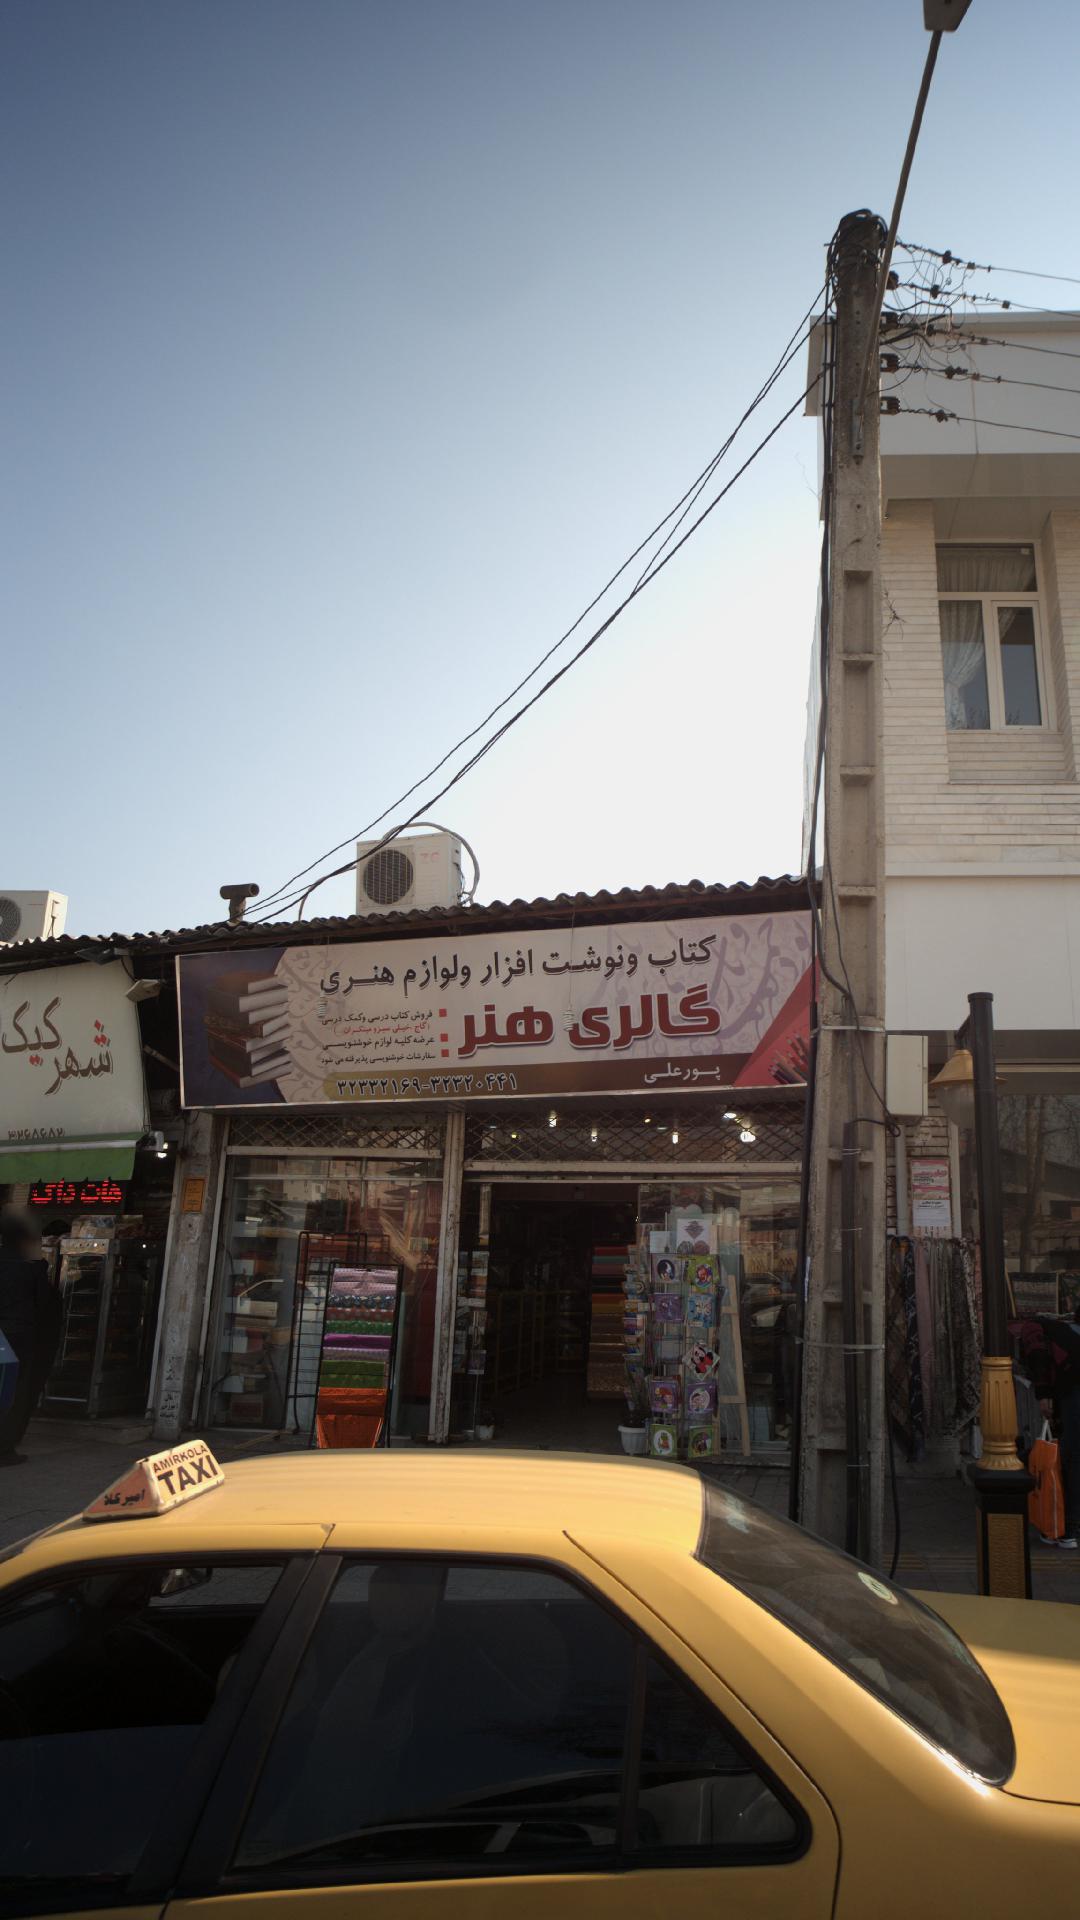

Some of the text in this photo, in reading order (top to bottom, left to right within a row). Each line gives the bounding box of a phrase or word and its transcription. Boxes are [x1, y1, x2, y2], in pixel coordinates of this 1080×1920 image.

[320, 934, 717, 998] کتاب ونوشت افزار ولوازم هنری
[321, 1016, 342, 1026] درسی
[367, 1014, 389, 1023] درسی
[391, 1010, 410, 1021] کتاب
[410, 1010, 433, 1021] فروش
[457, 983, 722, 1058] گالری هنر
[1, 996, 114, 1095] شهر کیک
[322, 1035, 435, 1050] عرضه کلیه لوازم خوشنویسی
[321, 1052, 436, 1066] سفارشات خوشنویسی پذیرفته می شود
[152, 1444, 209, 1474] AMIRKOLA
[157, 1454, 218, 1496] TAXI
